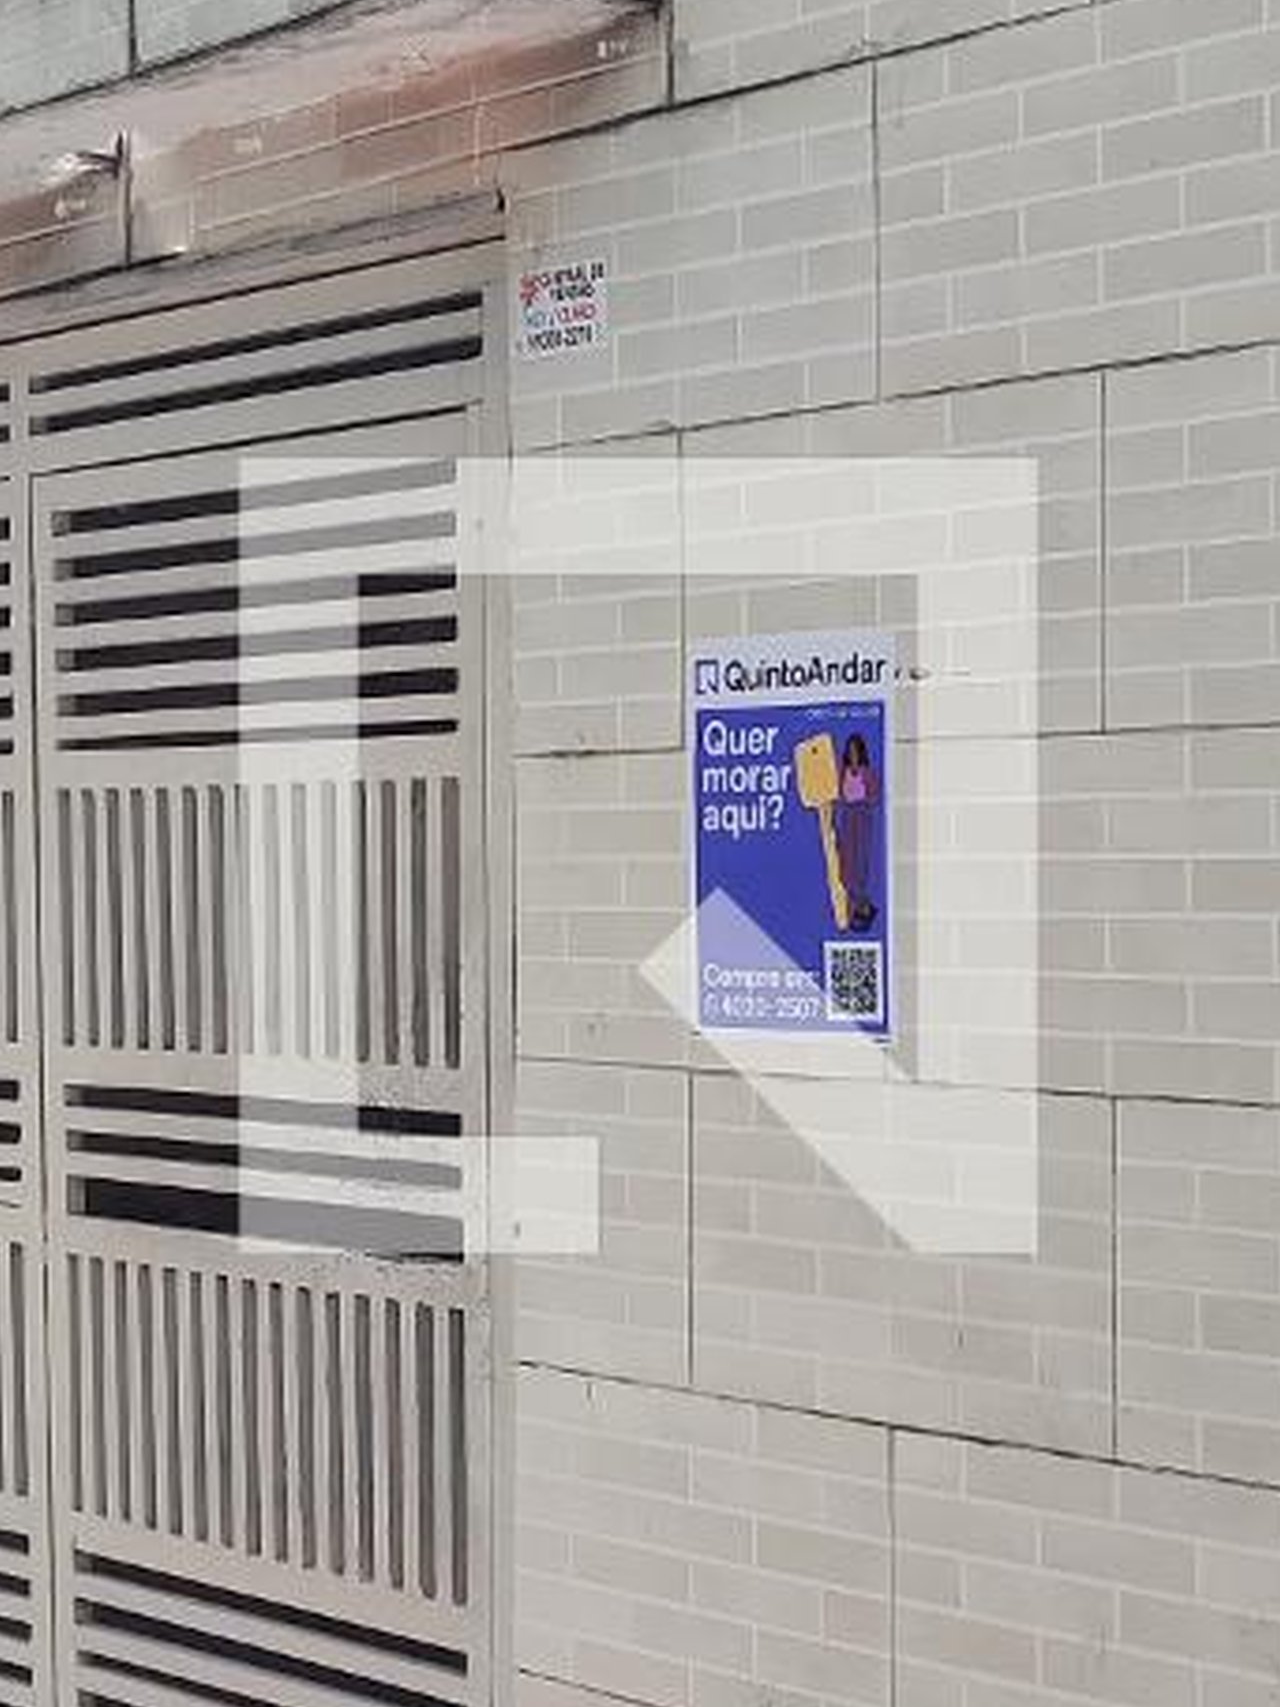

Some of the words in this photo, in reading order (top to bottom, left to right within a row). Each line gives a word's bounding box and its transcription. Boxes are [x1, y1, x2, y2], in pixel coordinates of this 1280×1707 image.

[724, 652, 886, 693] QuintoAndar
[702, 719, 779, 756] Quer
[702, 764, 791, 793] morar
[702, 794, 785, 840] aqui?
